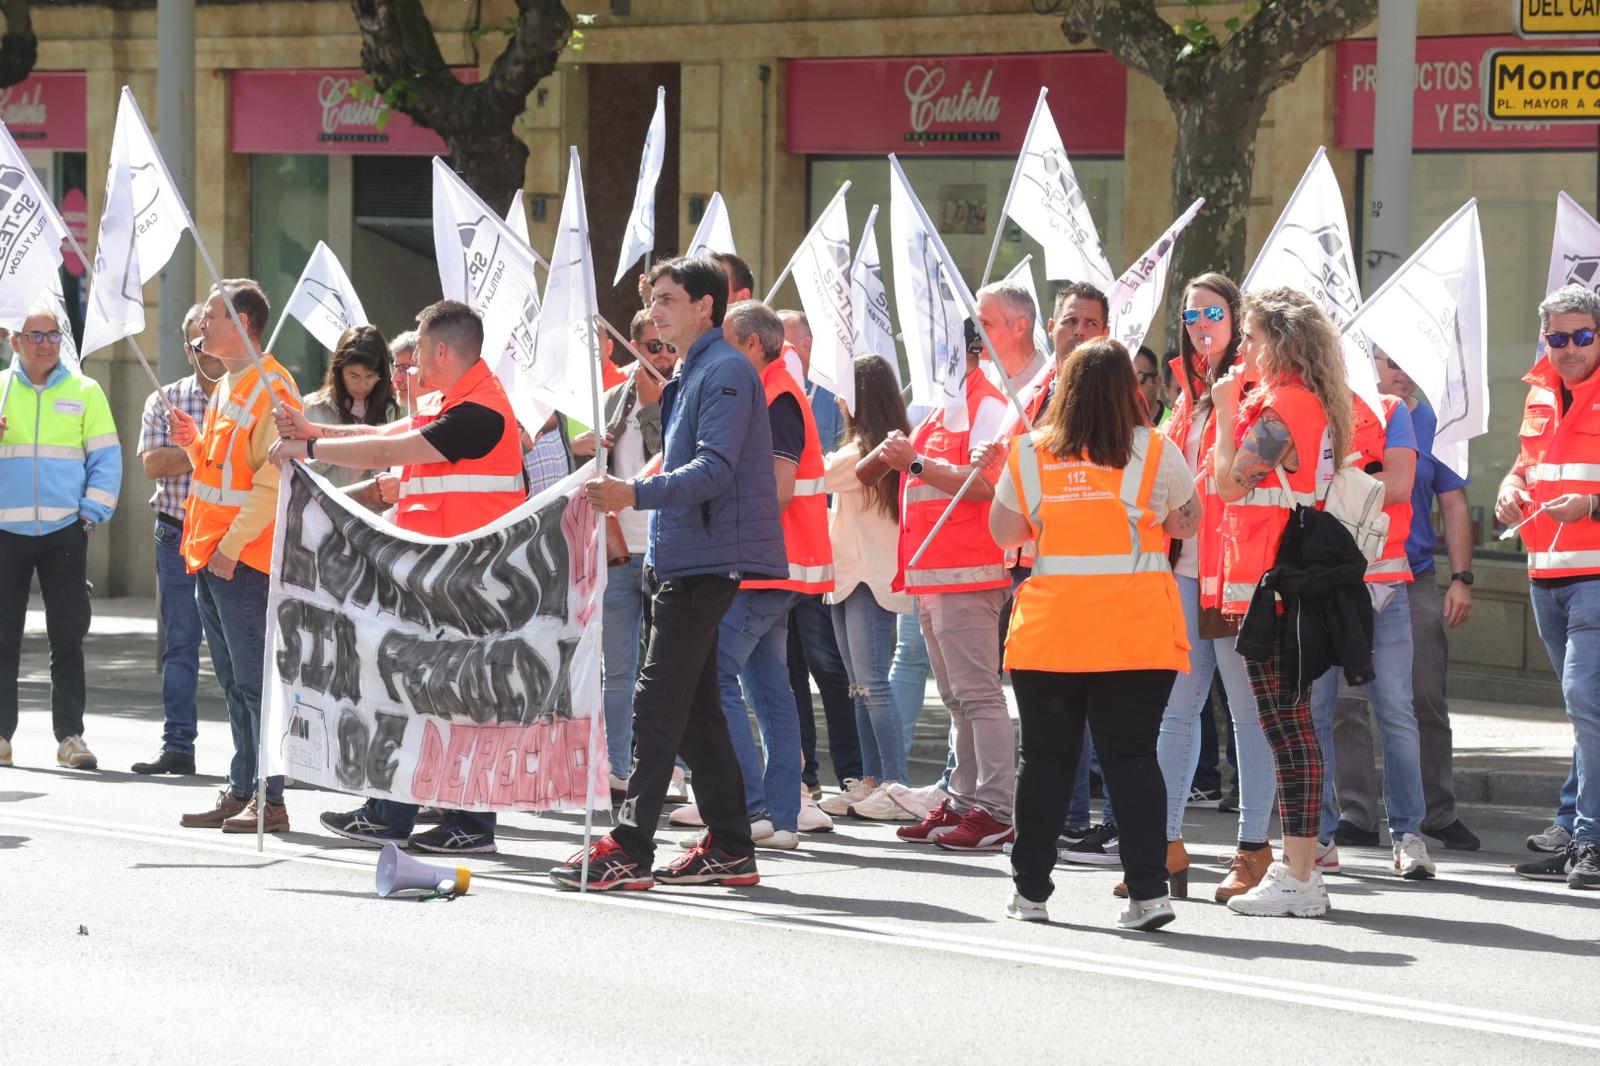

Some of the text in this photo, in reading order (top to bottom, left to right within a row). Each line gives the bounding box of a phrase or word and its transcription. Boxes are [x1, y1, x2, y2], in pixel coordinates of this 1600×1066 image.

[1528, 0, 1600, 16] DEL CA
[1352, 61, 1473, 92] PRCTOS
[904, 65, 1001, 134] Castela
[1497, 98, 1517, 110] PL.
[1523, 98, 1569, 110] MAYOR
[1576, 98, 1586, 110] A
[1435, 103, 1450, 132] Y
[1067, 471, 1087, 484] 112
[335, 707, 409, 795] DE
